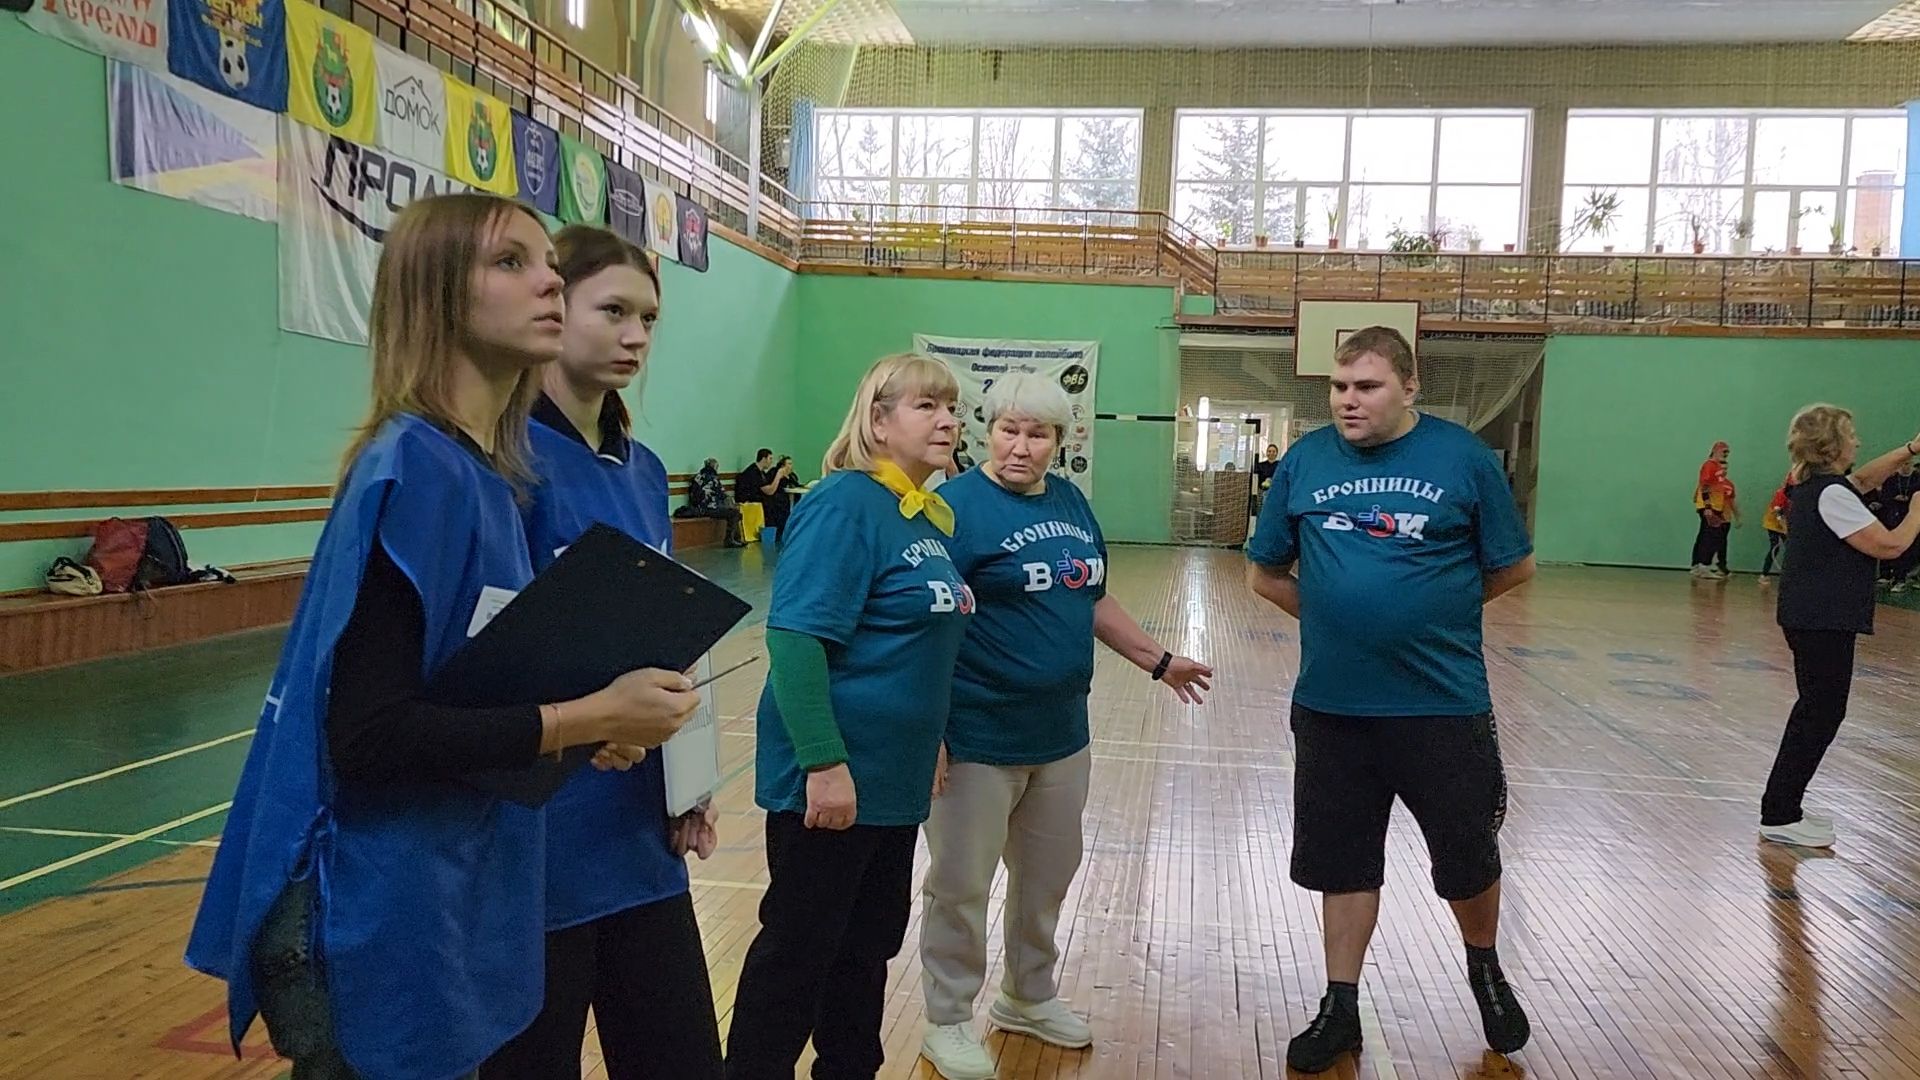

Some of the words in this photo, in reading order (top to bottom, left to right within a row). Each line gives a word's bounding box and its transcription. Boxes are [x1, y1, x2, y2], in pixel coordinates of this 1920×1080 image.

[384, 89, 441, 136] ДОМОК
[1062, 373, 1087, 386] ФВБ
[1311, 477, 1445, 504] БРОННИЦЫ
